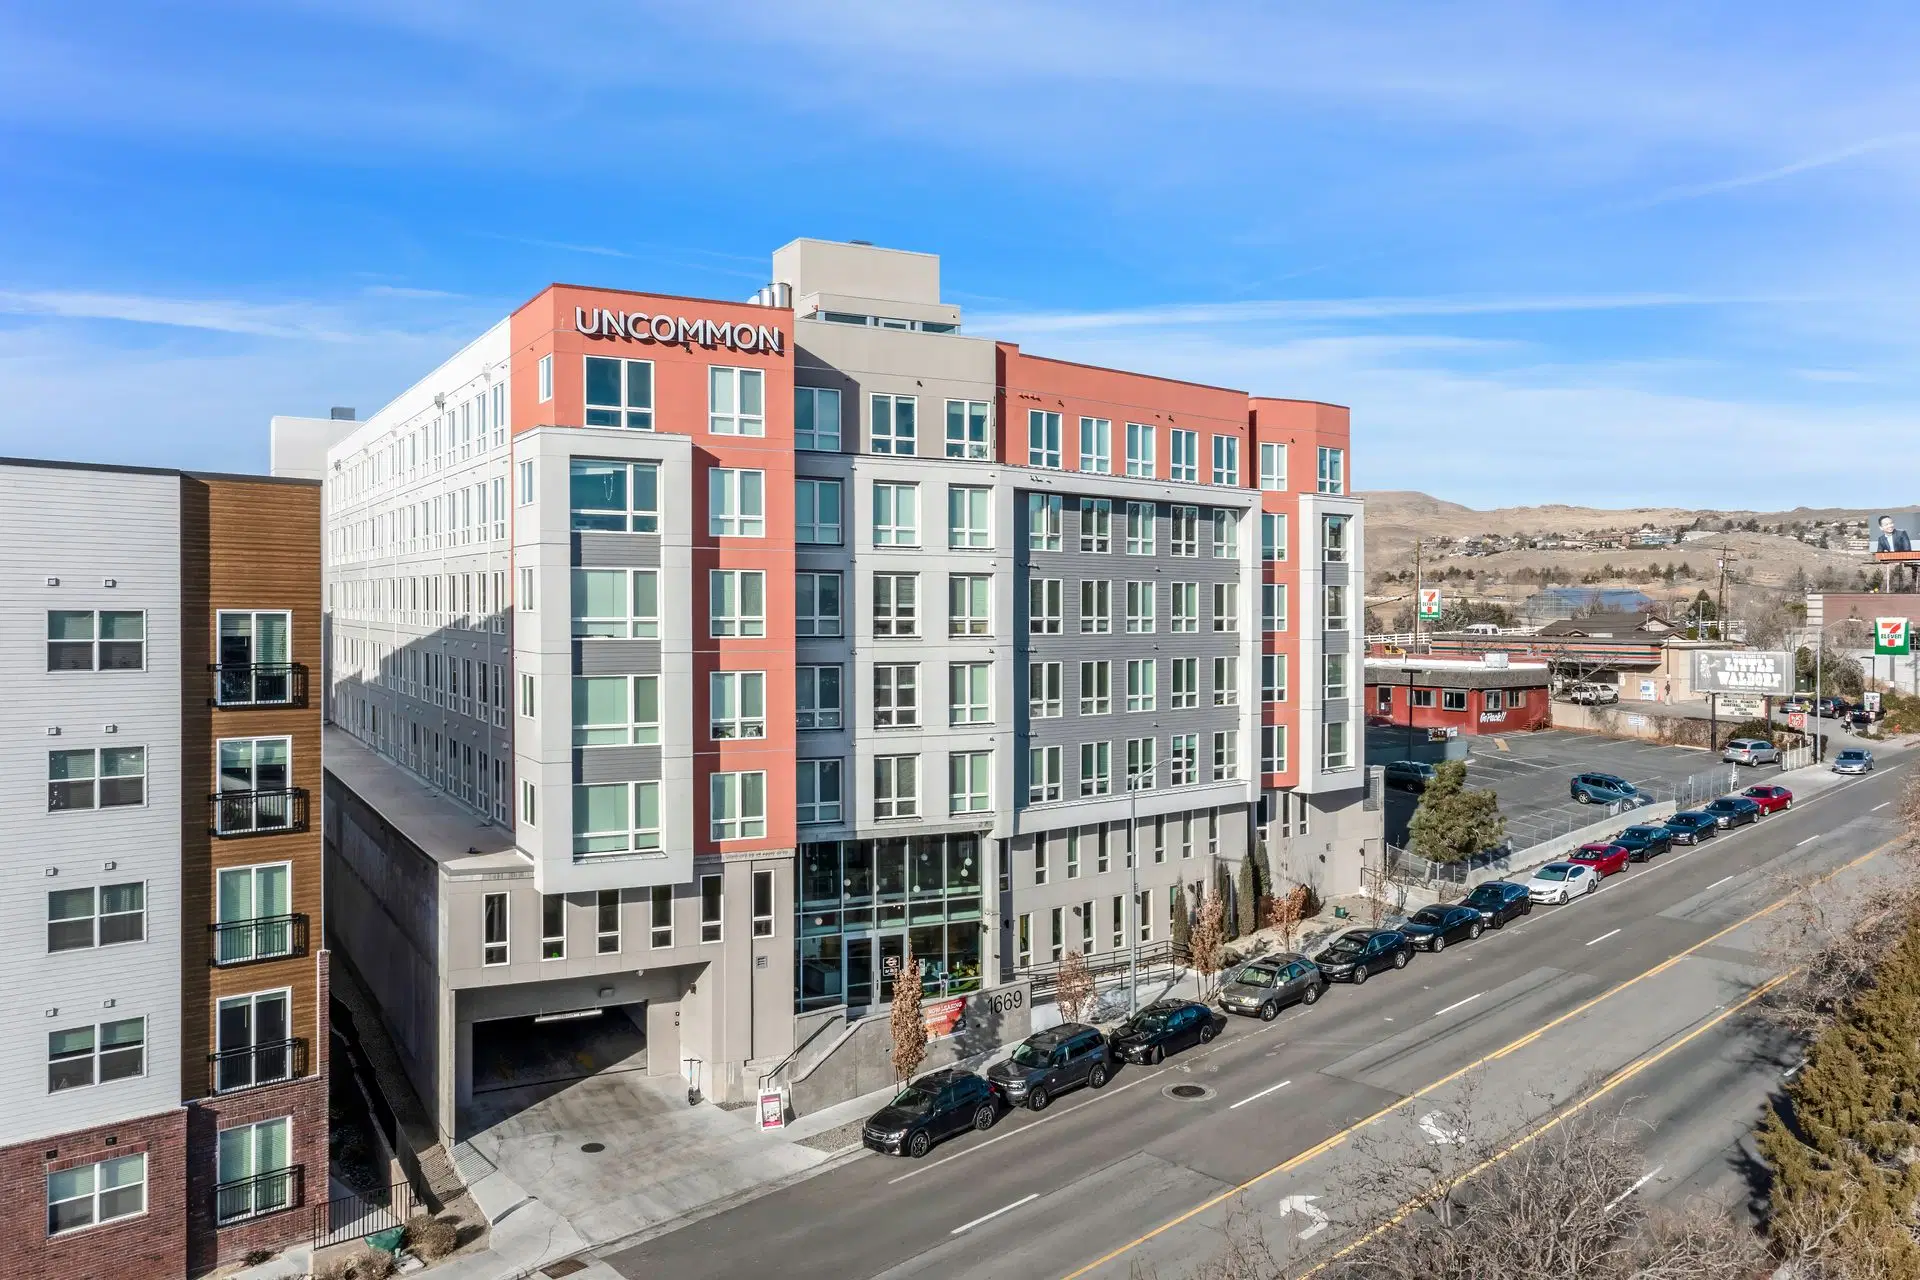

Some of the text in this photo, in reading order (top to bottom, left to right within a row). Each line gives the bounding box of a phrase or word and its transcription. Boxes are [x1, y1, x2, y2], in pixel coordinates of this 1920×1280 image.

[574, 306, 779, 352] UNCOMMON
[1424, 591, 1436, 613] 7
[1881, 622, 1902, 646] 7
[1724, 657, 1775, 673] LITTLE
[1717, 671, 1782, 688] WALDORF
[941, 1001, 962, 1011] LEASING
[988, 990, 1022, 1015] 1669
